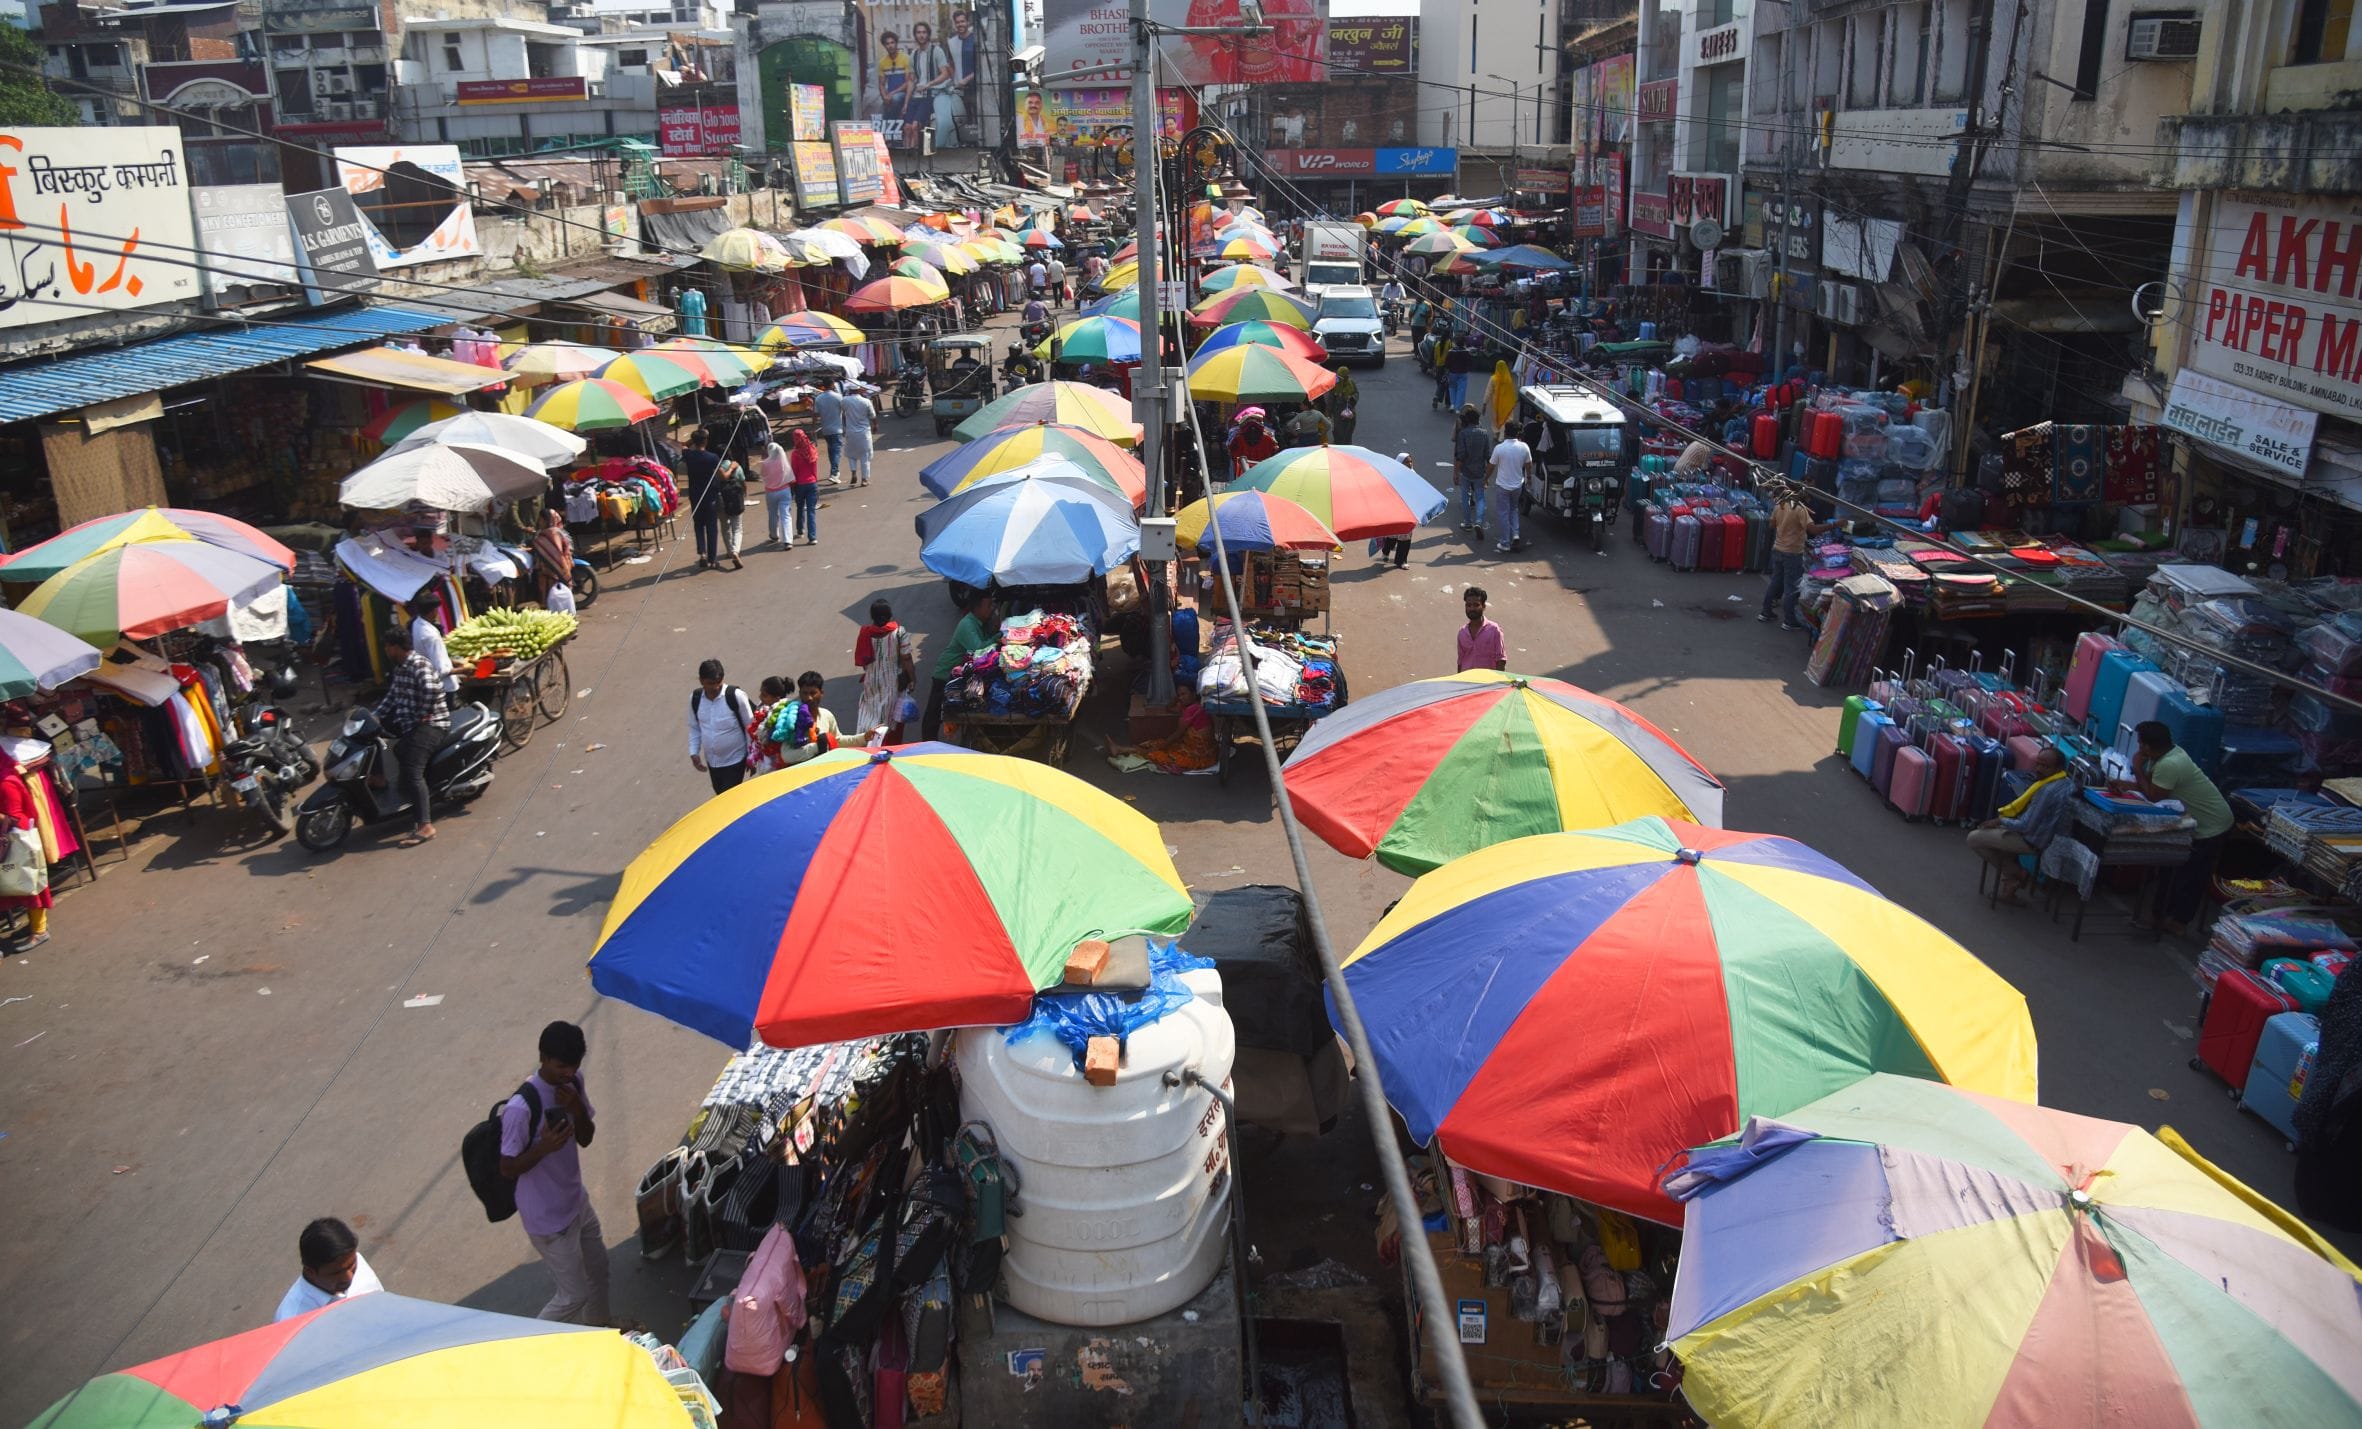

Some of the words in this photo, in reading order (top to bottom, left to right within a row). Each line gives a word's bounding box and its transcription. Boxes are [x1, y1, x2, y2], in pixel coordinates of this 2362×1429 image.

[1080, 23, 1129, 35] BROTHE
[1642, 86, 1669, 114] SINDH
[703, 130, 742, 145] Stores
[1298, 154, 1336, 169] VIP
[1335, 161, 1369, 169] WORLD
[28, 155, 112, 204] बिस्कुट
[113, 149, 178, 189] कम्पनी
[316, 222, 363, 248] GARMENTS
[60, 201, 144, 298] برما
[2235, 211, 2362, 300] AKH
[2204, 288, 2307, 367] PAPER
[2249, 442, 2303, 470] SERVICE
[2254, 434, 2288, 451] SALE
[2291, 447, 2301, 457] &
